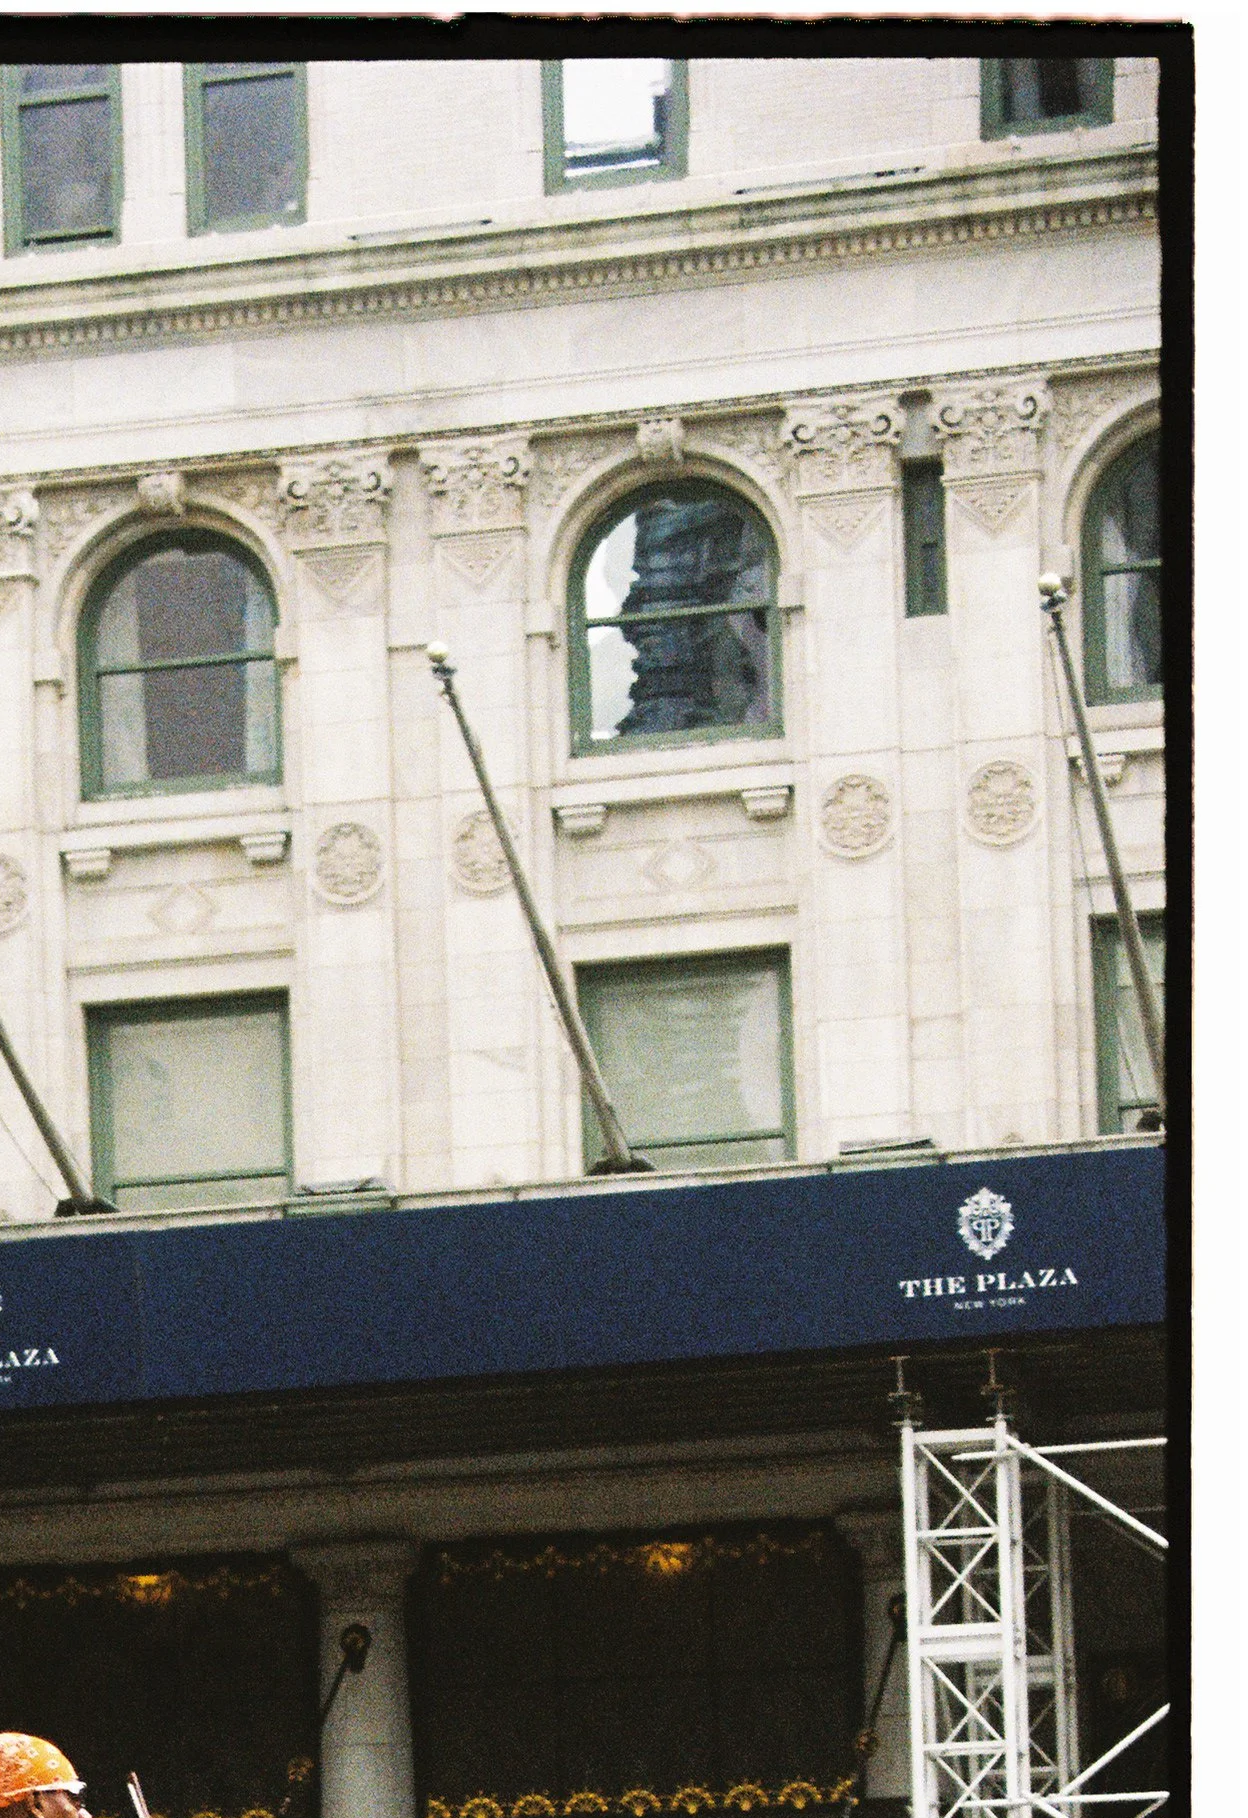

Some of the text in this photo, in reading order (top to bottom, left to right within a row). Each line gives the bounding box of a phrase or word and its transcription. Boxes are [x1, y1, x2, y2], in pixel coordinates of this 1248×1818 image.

[899, 1267, 1079, 1298] THE PLAZA
[954, 1296, 1026, 1310] NEW YORK
